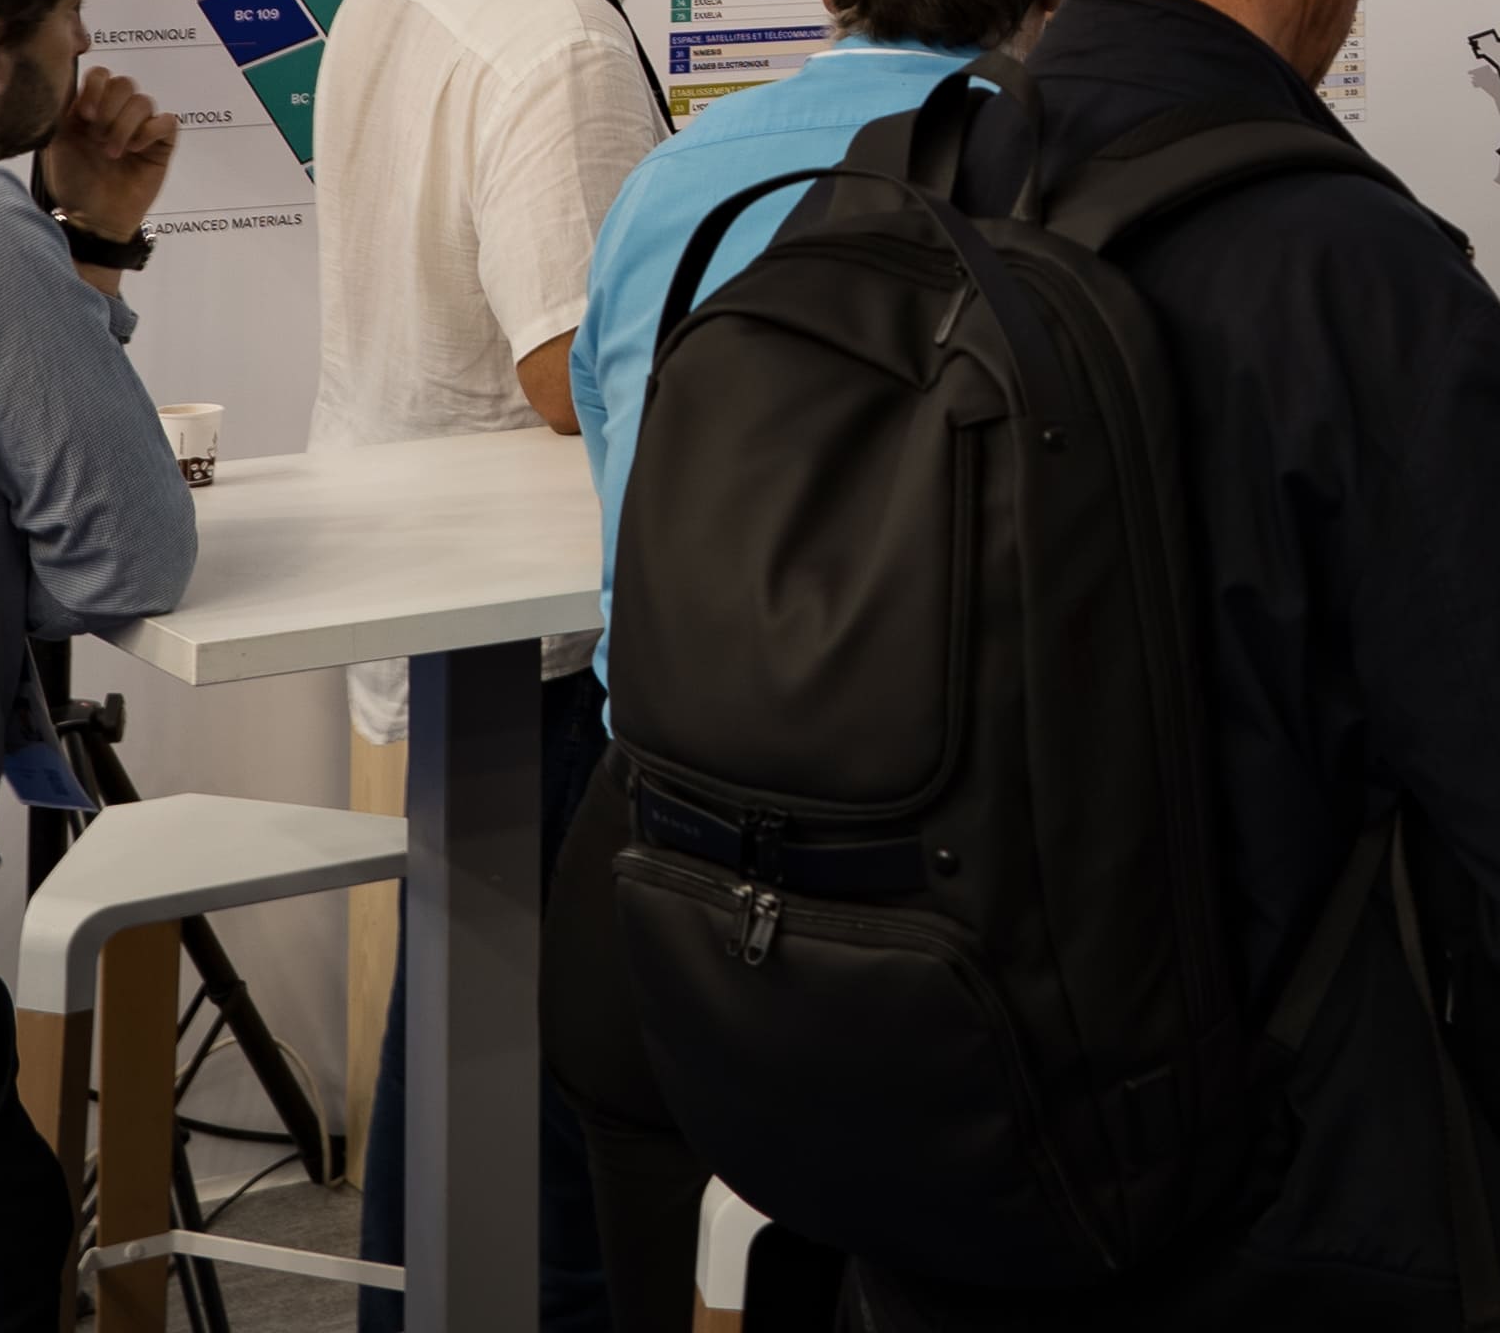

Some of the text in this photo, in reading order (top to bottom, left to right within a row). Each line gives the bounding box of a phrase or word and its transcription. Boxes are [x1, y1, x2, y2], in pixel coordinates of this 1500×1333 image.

[234, 9, 280, 21] BC 109
[94, 28, 196, 43] ÉLECTRONIQUE
[291, 94, 310, 104] BC
[176, 111, 233, 124] NITOOLS
[156, 213, 303, 235] ADVANCED MATERIALS
